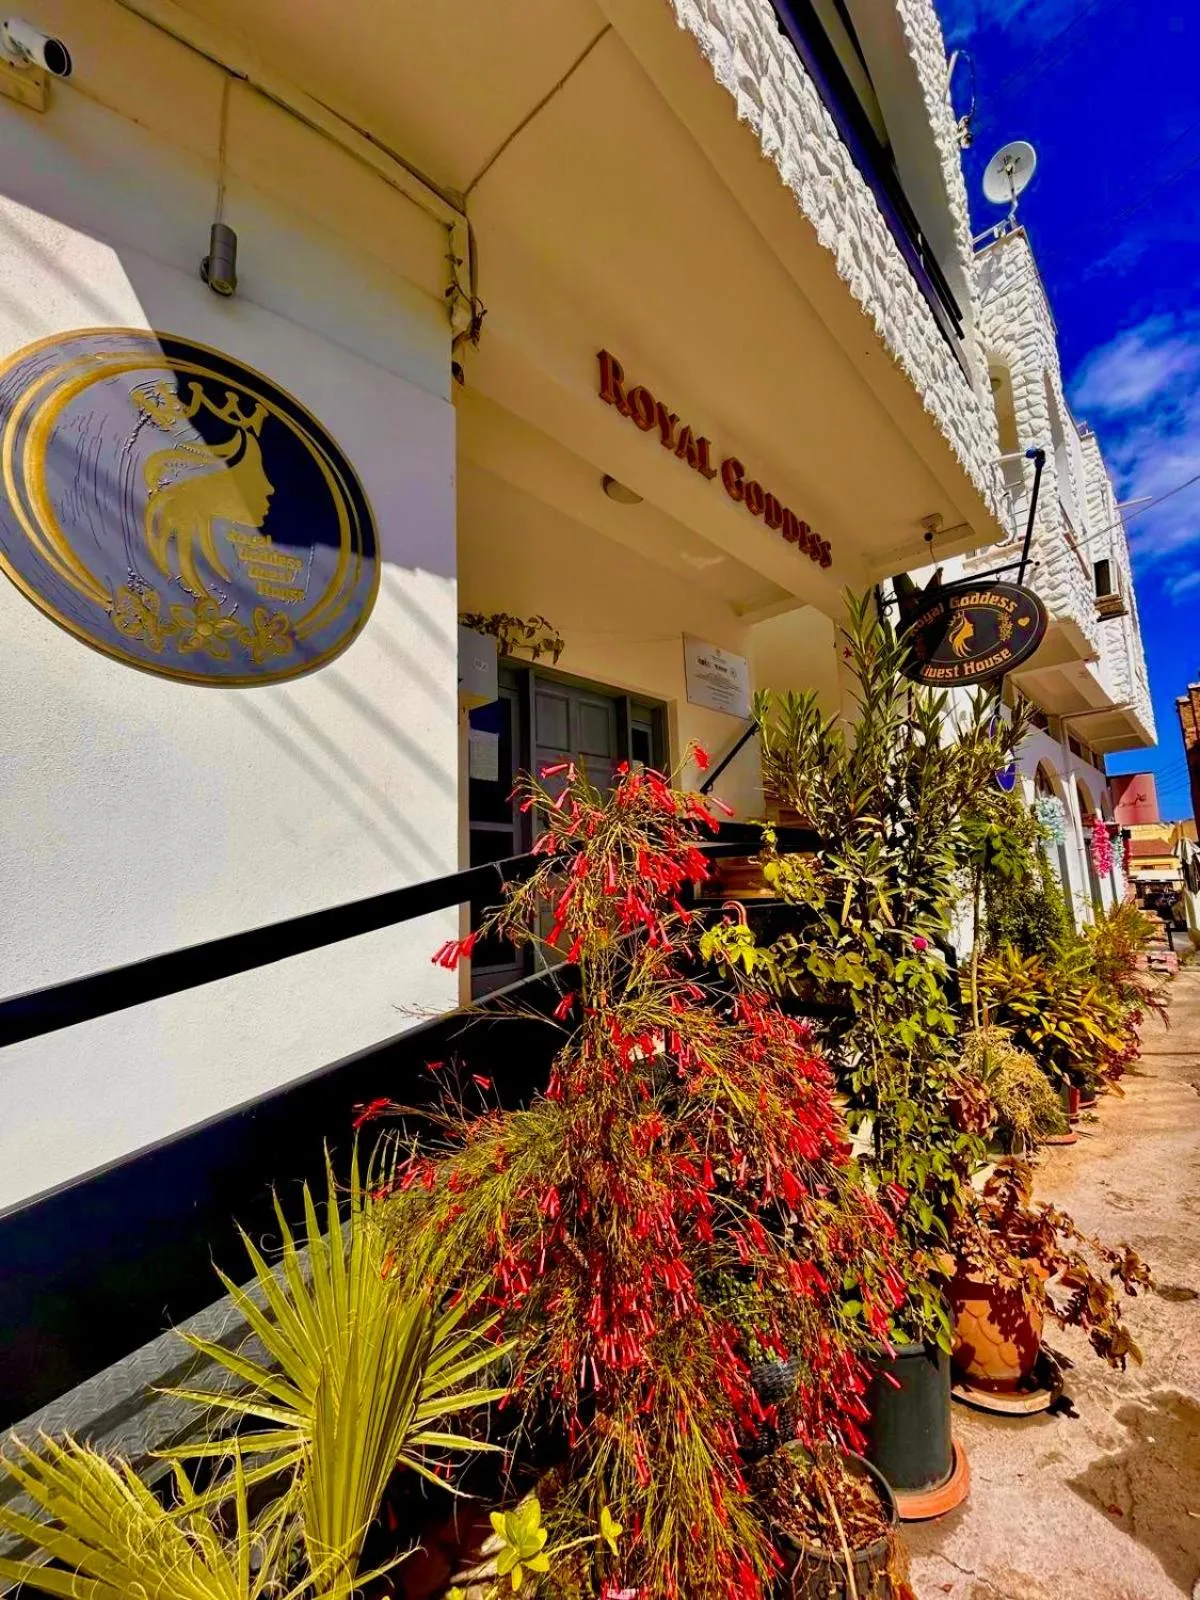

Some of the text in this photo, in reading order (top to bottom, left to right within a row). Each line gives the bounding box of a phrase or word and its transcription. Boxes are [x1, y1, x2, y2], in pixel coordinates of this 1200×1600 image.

[597, 349, 717, 480] ROYAL
[950, 592, 1019, 614] Goddess
[964, 647, 1012, 675] House
